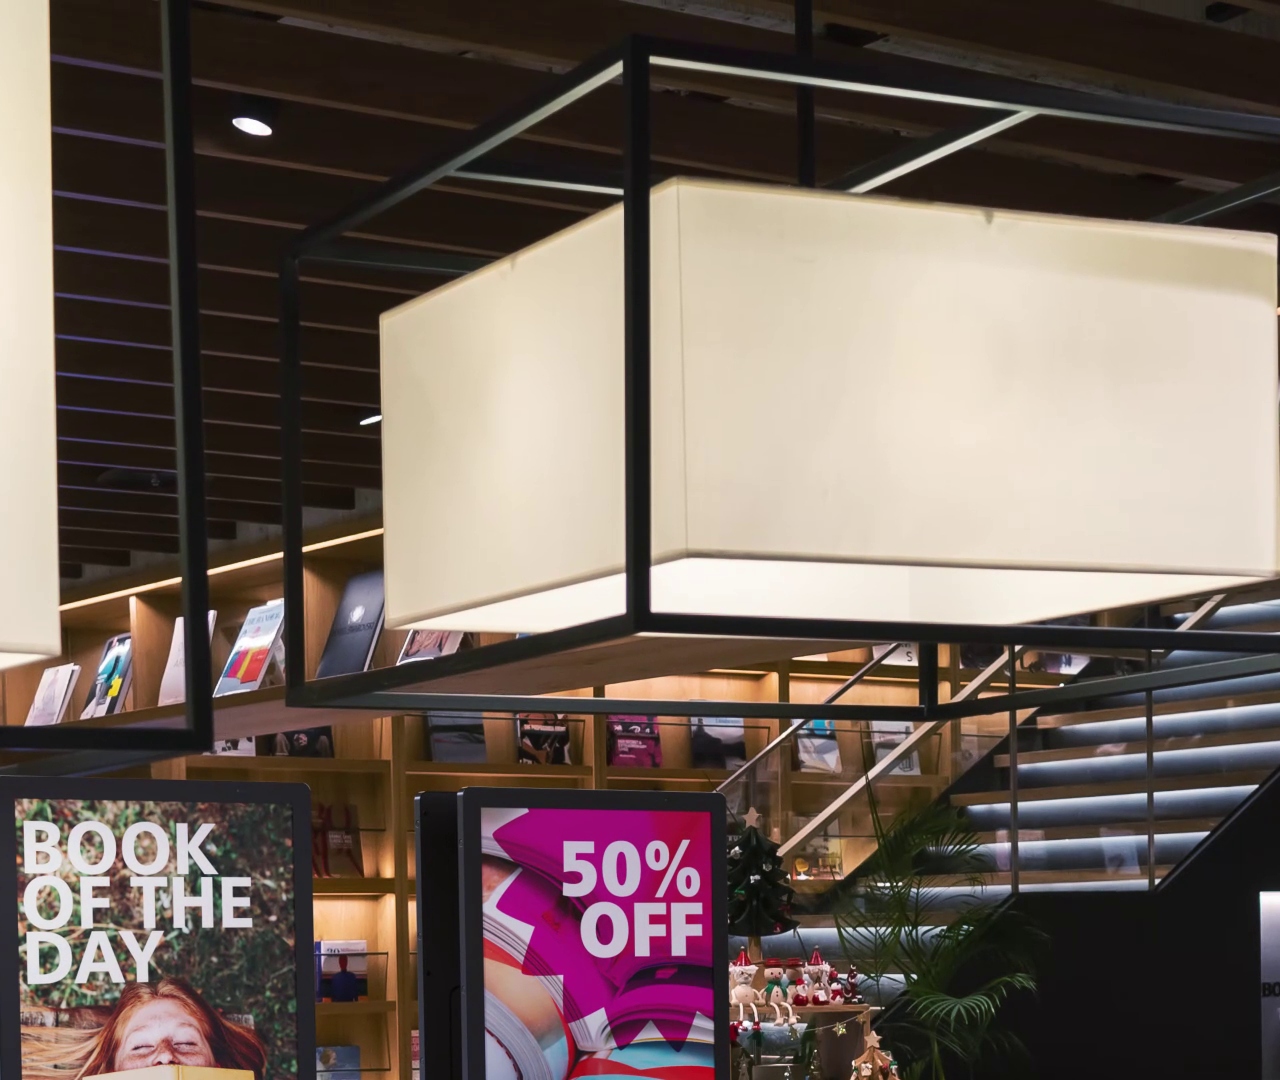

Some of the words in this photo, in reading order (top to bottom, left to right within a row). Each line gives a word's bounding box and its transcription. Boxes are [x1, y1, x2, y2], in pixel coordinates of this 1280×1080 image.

[23, 820, 219, 876] BOOK
[561, 839, 701, 899] 50%
[23, 876, 111, 931] OF
[129, 876, 253, 929] THE
[580, 902, 703, 958] OFF
[26, 930, 164, 985] DAY
